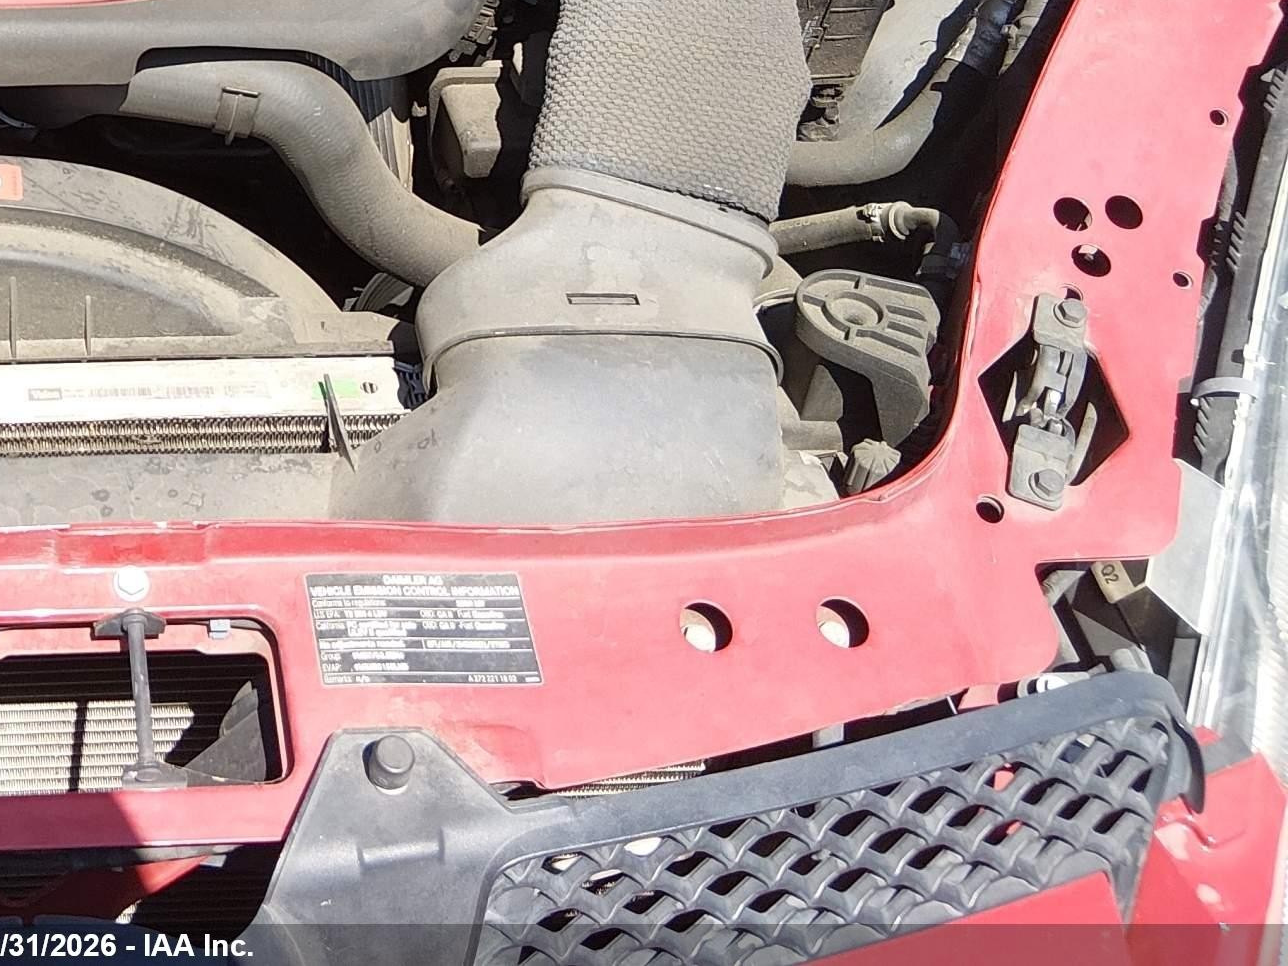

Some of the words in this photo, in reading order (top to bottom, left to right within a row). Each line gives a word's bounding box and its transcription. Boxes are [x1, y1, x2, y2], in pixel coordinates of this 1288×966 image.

[309, 585, 352, 596] VEHICLE
[353, 585, 402, 596] EMISSION
[403, 586, 450, 596] CONTROL
[451, 586, 520, 596] INFORMATION
